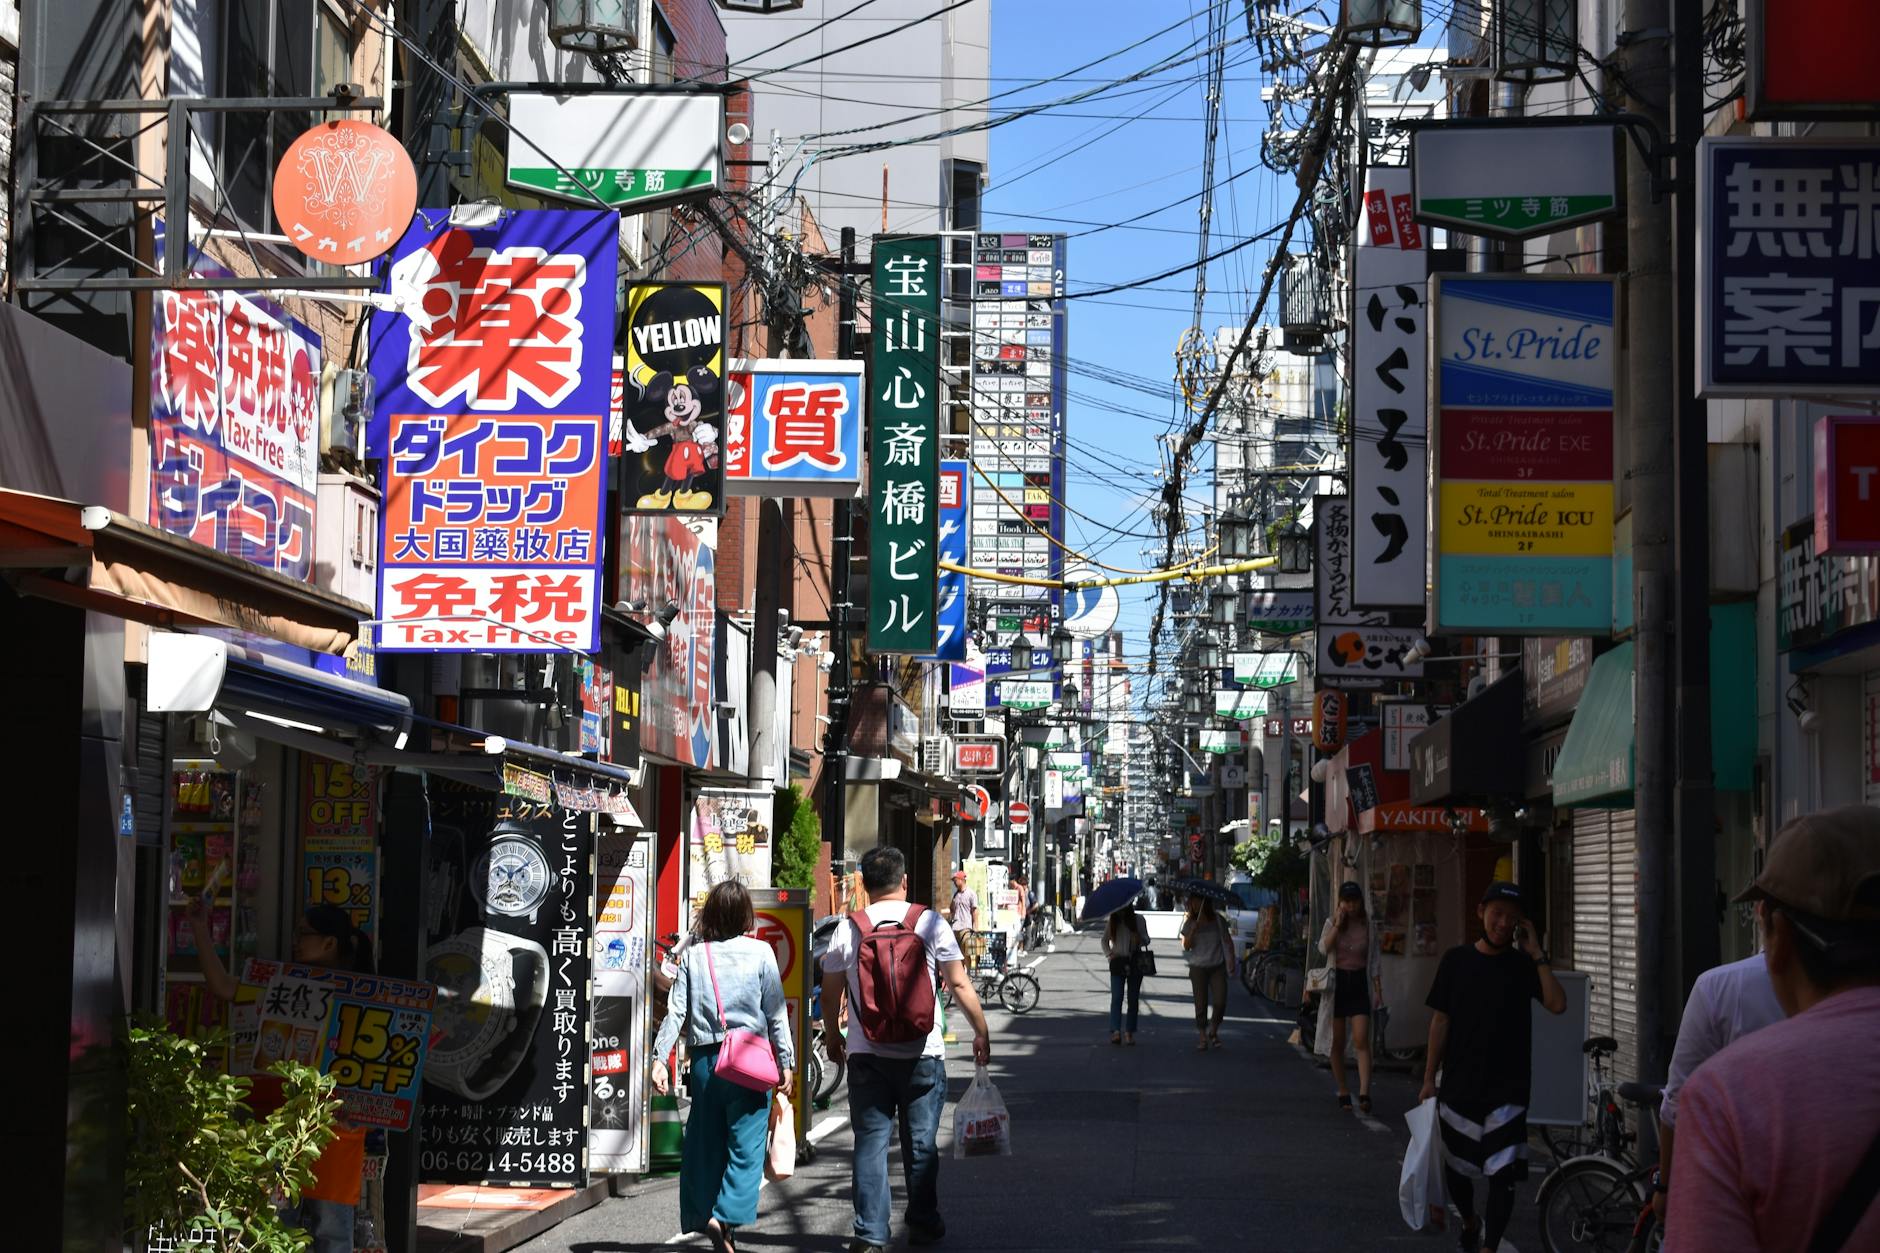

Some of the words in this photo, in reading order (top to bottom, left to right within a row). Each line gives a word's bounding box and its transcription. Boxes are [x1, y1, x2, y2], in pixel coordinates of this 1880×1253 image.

[555, 169, 667, 193] 三ツ寺筋
[1464, 196, 1569, 219] 三ツ寺筋
[292, 222, 393, 253] ワカイケ
[416, 253, 584, 406] 薬
[633, 315, 722, 355] YELLOW
[1454, 324, 1600, 361] St.Pride
[224, 301, 287, 434] 免税
[225, 409, 285, 471] Tax-Free
[765, 386, 845, 468] 質
[881, 254, 929, 635] 宝山心斎橋ビル
[1460, 428, 1552, 452] St.Pride
[1559, 435, 1593, 451] EXE
[392, 419, 598, 477] ダイコク
[410, 477, 567, 525] ドラッグ
[1477, 488, 1502, 499] Total
[1504, 488, 1550, 499] Treatment
[1551, 488, 1576, 499] salon
[1457, 503, 1549, 526] St.Pride
[1557, 511, 1594, 526] ICU
[394, 527, 591, 561] 大国藥妝店
[1487, 530, 1564, 539] SHINSAIBASHI
[1517, 541, 1534, 551] 2F
[1326, 504, 1349, 617] 名物かすうどん
[391, 573, 587, 623] 免税
[398, 625, 578, 644] Tax-Free
[312, 762, 370, 799] 15%
[310, 801, 370, 825] OFF
[712, 813, 746, 835] bag
[703, 832, 756, 854] 免税
[307, 867, 371, 906] 13%
[552, 808, 583, 1104] どこよりも高く買取ります
[334, 1002, 421, 1068] 15%
[327, 1057, 415, 1094] OFF
[594, 1075, 626, 1100] る。
[421, 1150, 576, 1174] 06-6214-5488
